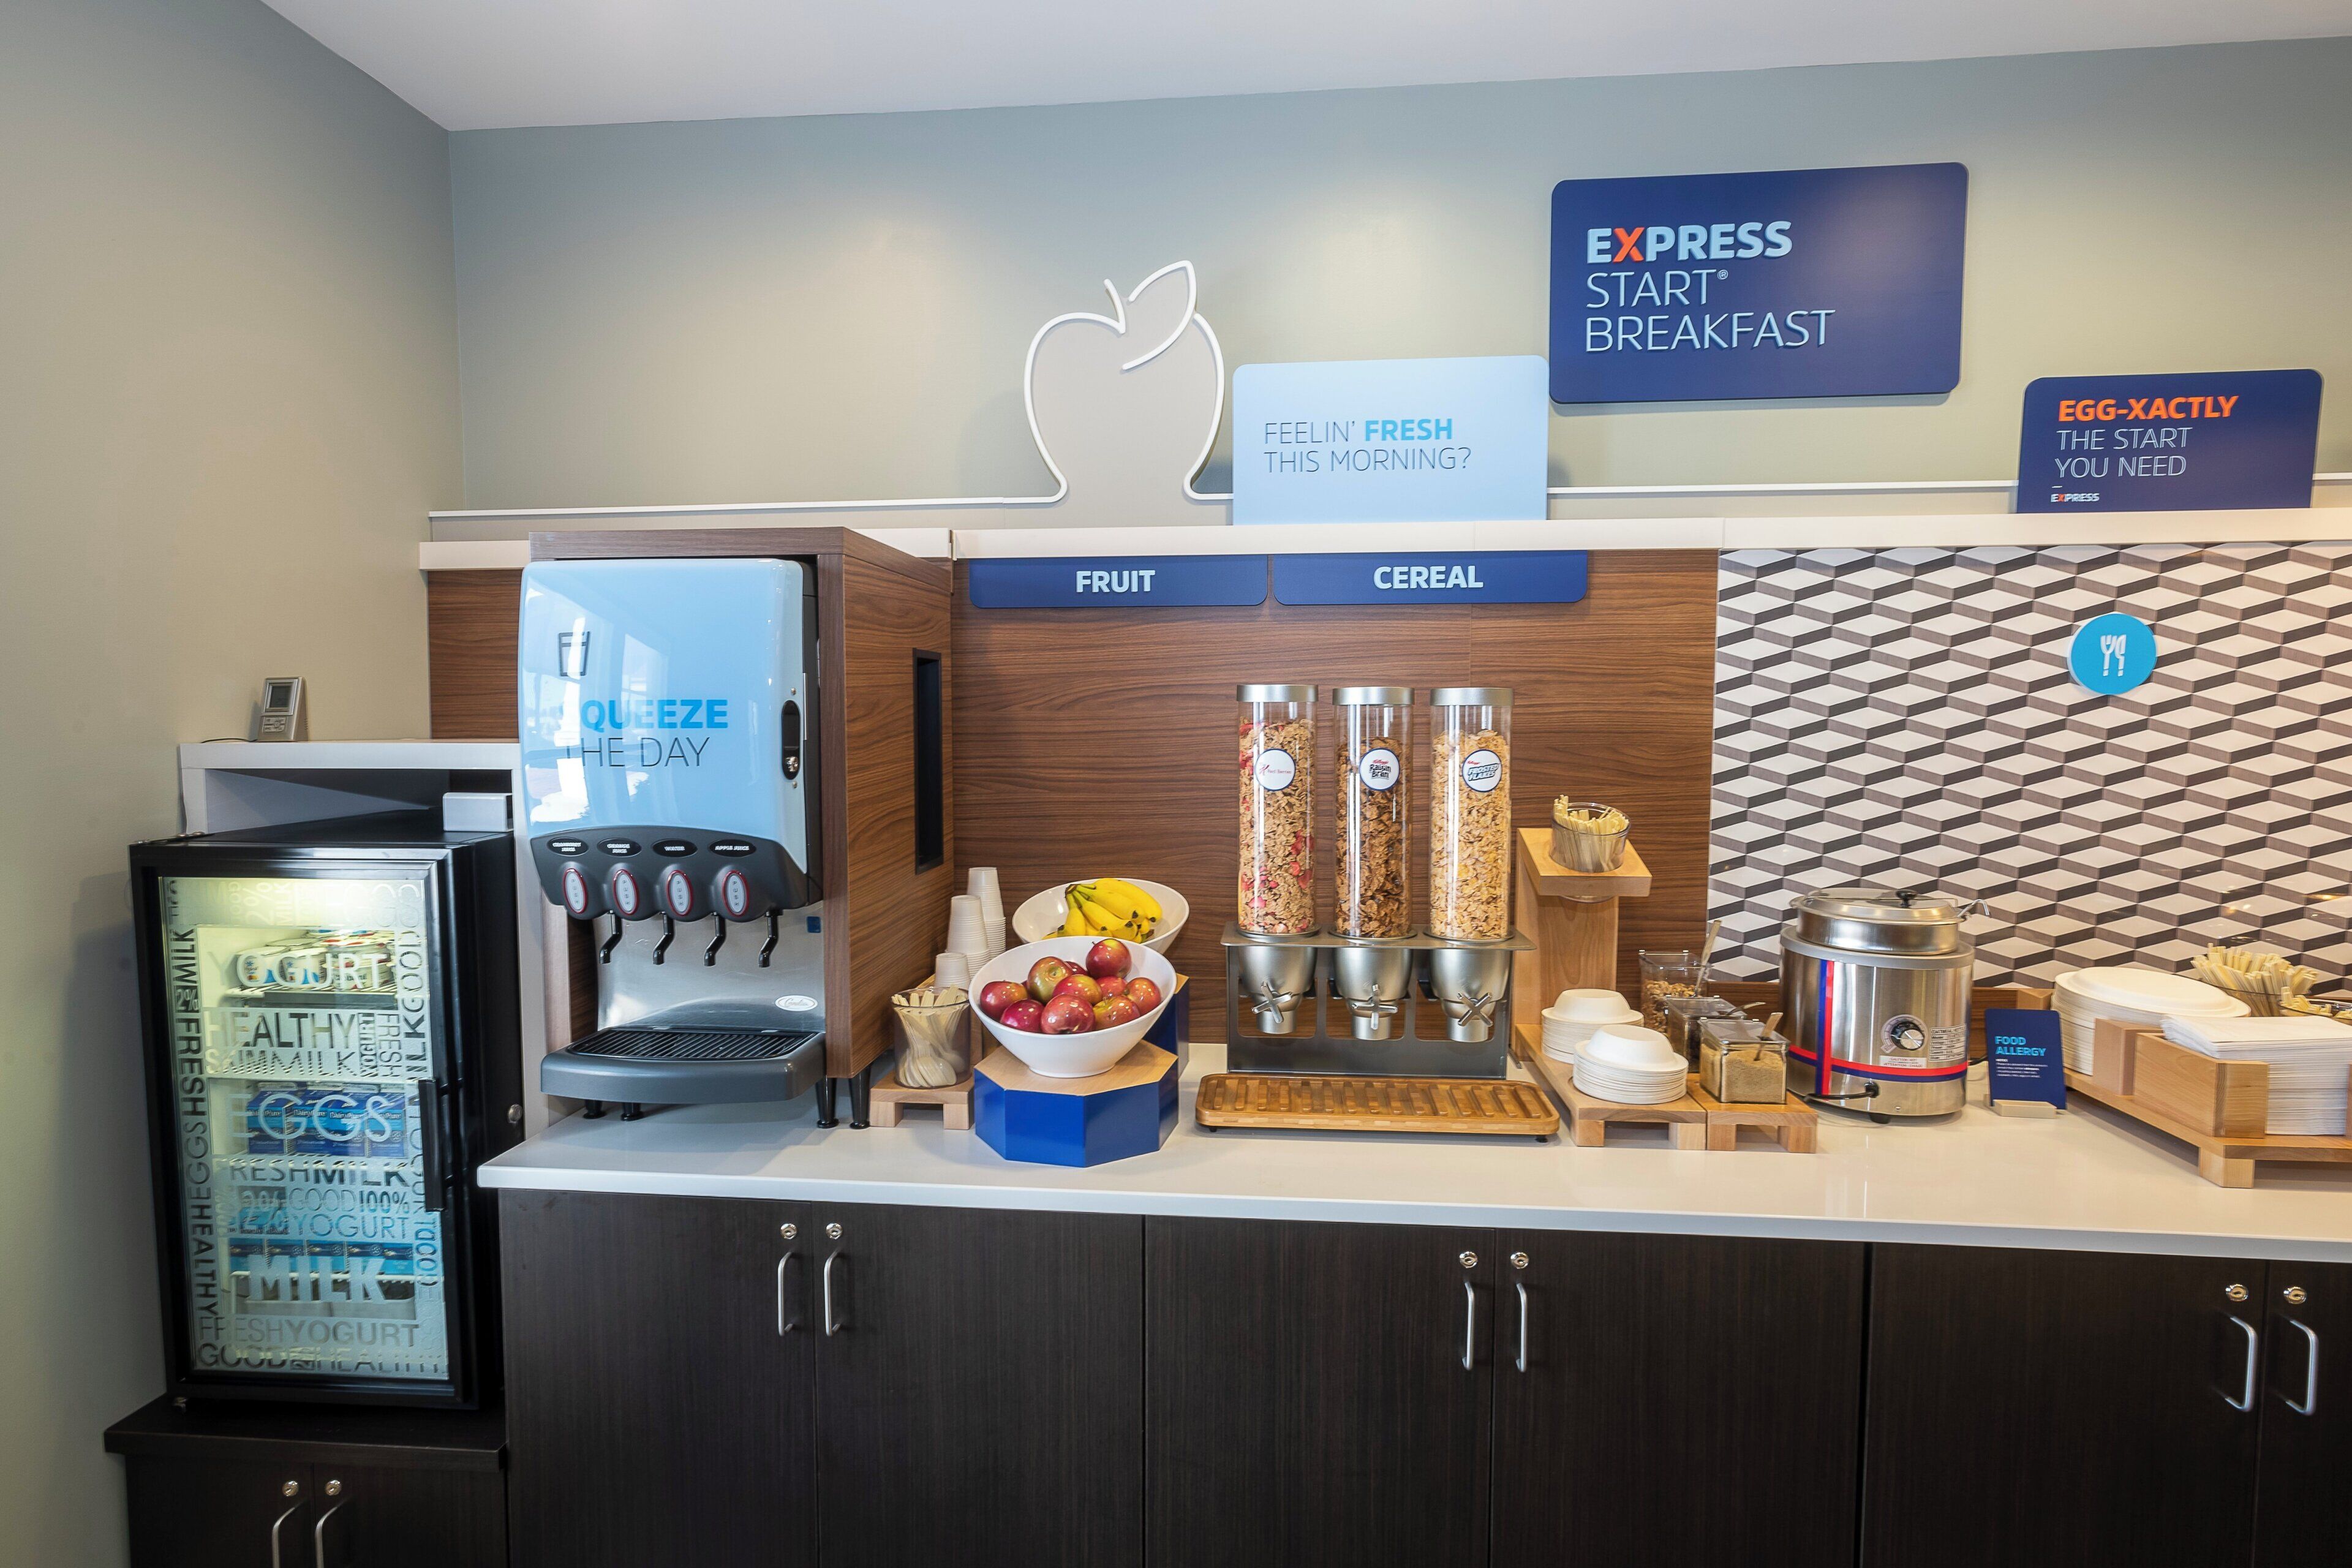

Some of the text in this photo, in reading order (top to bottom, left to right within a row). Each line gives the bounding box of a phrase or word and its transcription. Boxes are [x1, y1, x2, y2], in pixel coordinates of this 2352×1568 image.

[1587, 221, 1792, 263] EXPRESS
[1586, 309, 1836, 352] BREAKFAST
[2058, 395, 2239, 421] EGG-XACTLY
[1365, 418, 1452, 442] FRESH
[2056, 427, 2193, 450] THE START
[1264, 447, 1471, 473] THIS MORNING?
[2054, 455, 2187, 478] YOU NEED
[2051, 492, 2100, 502] EXPRESS
[1076, 569, 1156, 594] FRUIT
[1373, 565, 1483, 590] CEREAL
[581, 699, 728, 733] QUEEZE
[641, 737, 710, 767] DAY
[1370, 764, 1391, 773] Raisin
[170, 929, 200, 984] MILK
[208, 951, 388, 989] YOGURT
[398, 930, 424, 1012] GOOD
[205, 1011, 356, 1048] HEALTHY
[1994, 1036, 2026, 1045] FOOD
[377, 1014, 402, 1077] FRESH
[1995, 1046, 2046, 1057] ALLERGY
[175, 1017, 208, 1116] FRESH
[227, 1093, 391, 1142] EGGS
[184, 1122, 211, 1200] EGGS
[289, 1187, 356, 1212] GOOD
[293, 1213, 409, 1240] YOGURT
[187, 1204, 219, 1316] HEALTHY
[249, 1254, 388, 1304] MILK
